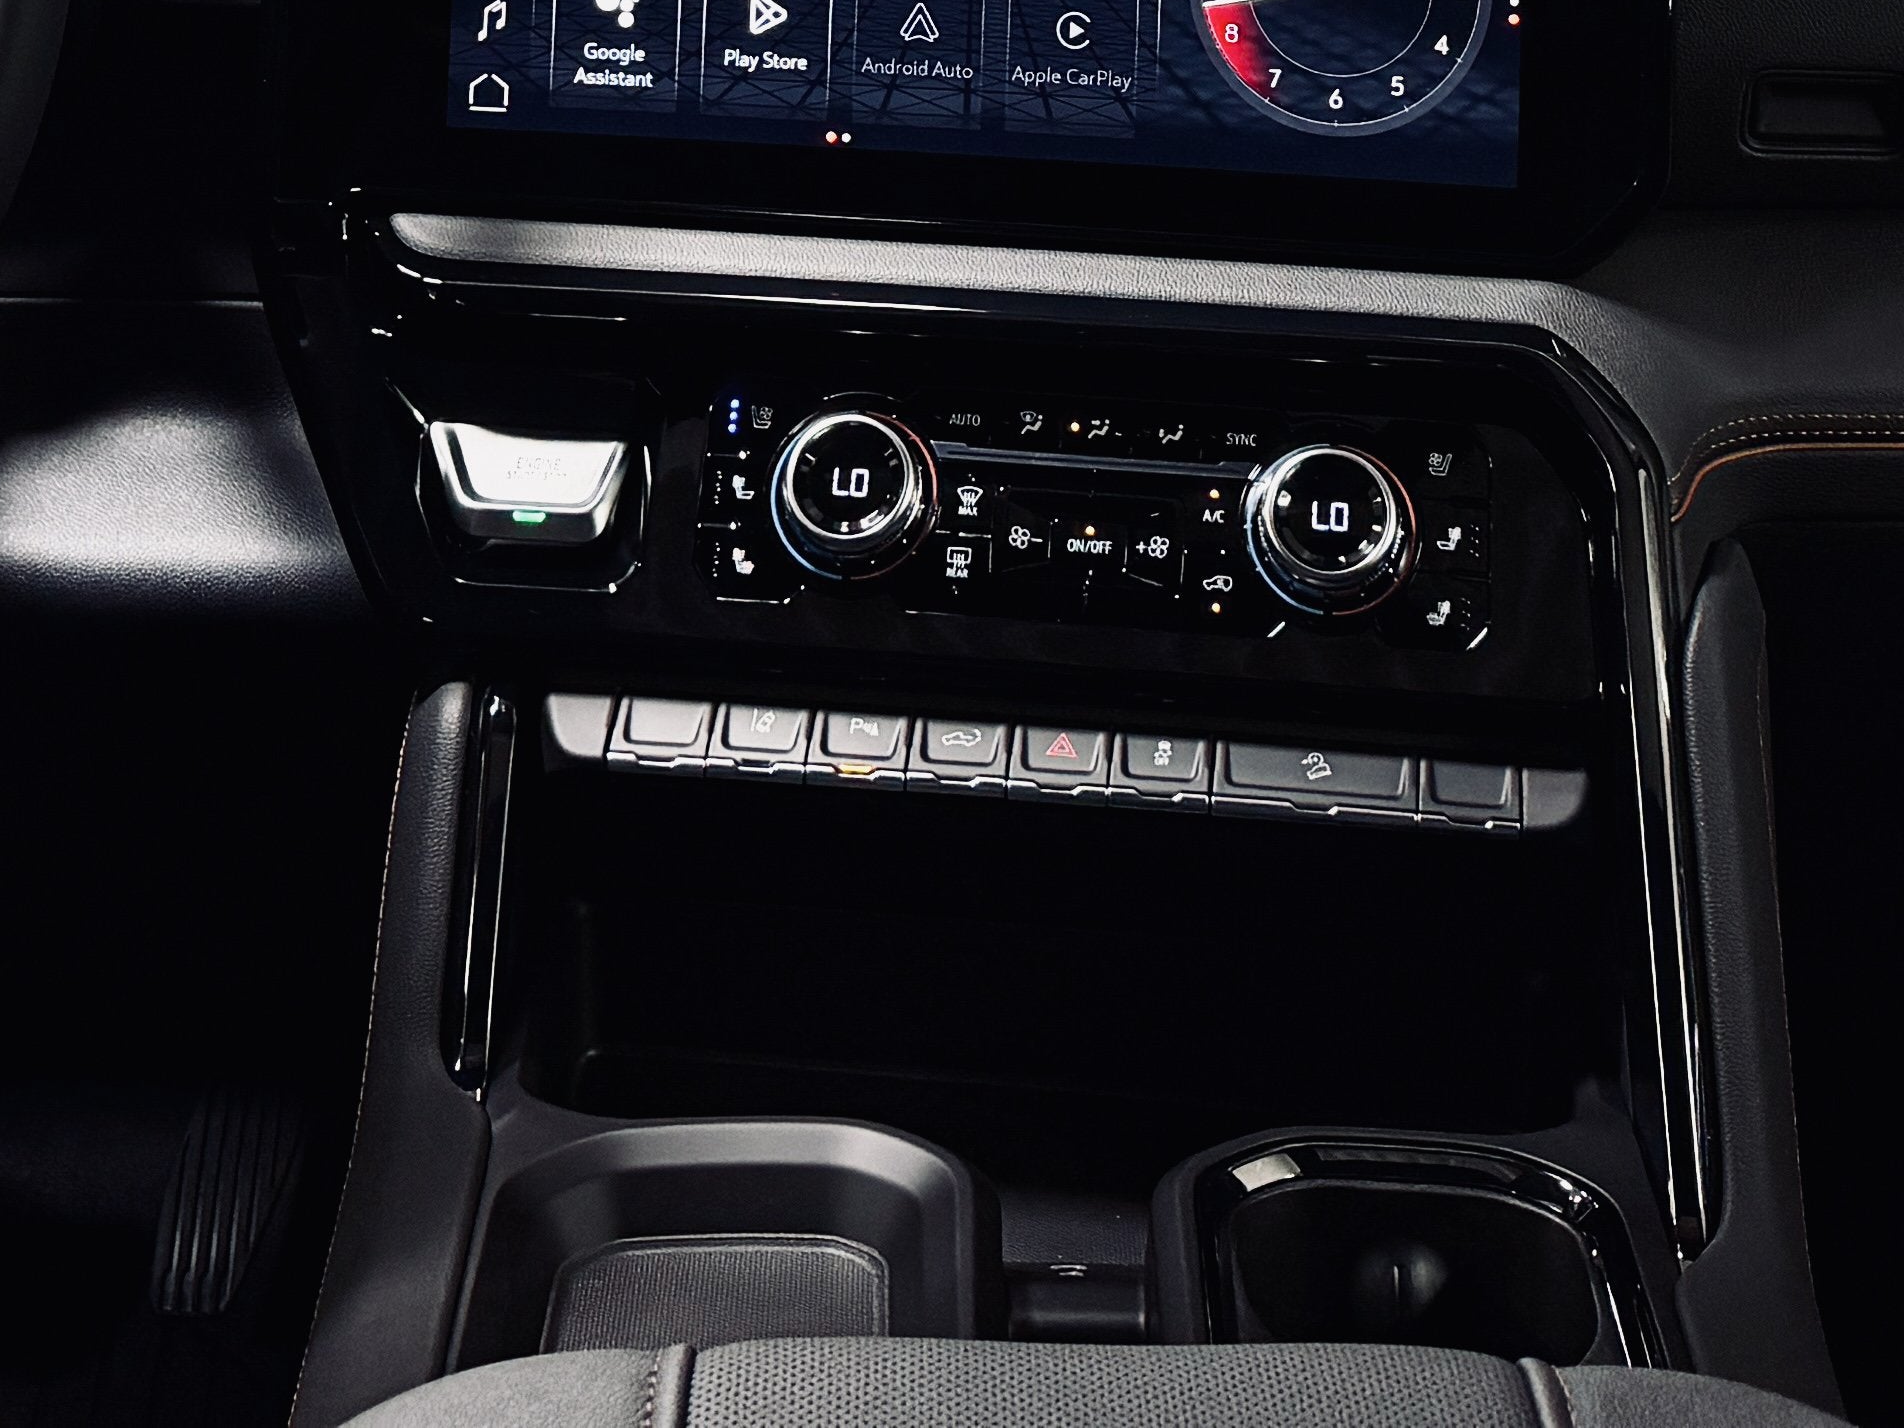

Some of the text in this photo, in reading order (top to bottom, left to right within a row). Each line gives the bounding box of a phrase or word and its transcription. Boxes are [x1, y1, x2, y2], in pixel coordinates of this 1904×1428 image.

[1224, 23, 1240, 44] 8
[583, 43, 646, 68] Google
[1433, 34, 1451, 56] 4
[723, 49, 808, 73] Play Store
[861, 56, 973, 79] Android Auto
[573, 67, 654, 89] Assistant
[1012, 65, 1132, 92] Apple CarPlay
[1268, 69, 1283, 88] 7
[1390, 75, 1405, 97] 5
[1328, 88, 1344, 110] 6
[948, 413, 981, 427] AUTO
[1225, 432, 1258, 447] SYNC
[831, 467, 870, 499] LO
[957, 505, 979, 517] MAX
[1202, 508, 1226, 524] A/C
[1310, 500, 1350, 533] LO
[1066, 537, 1113, 555] ON/OFF
[945, 567, 969, 579] REAR
